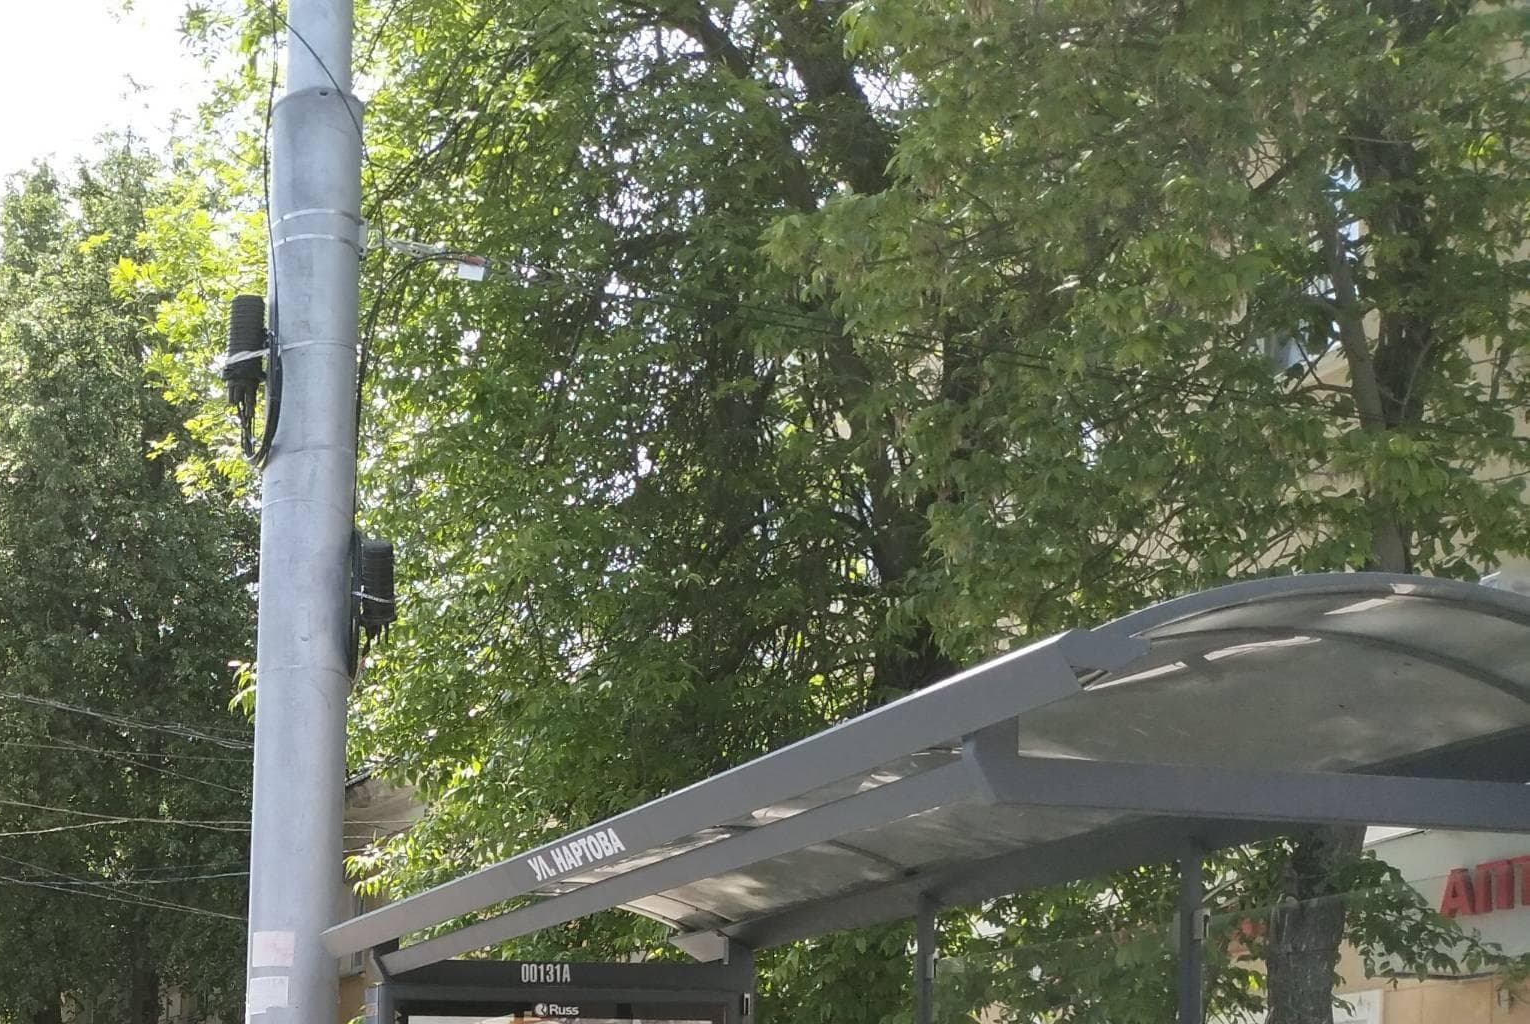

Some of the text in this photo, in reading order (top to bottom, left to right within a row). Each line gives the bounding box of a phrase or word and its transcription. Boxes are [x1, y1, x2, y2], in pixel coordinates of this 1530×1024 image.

[527, 827, 626, 881] УЛ. НАРТОВА
[549, 1003, 580, 1016] Russ
